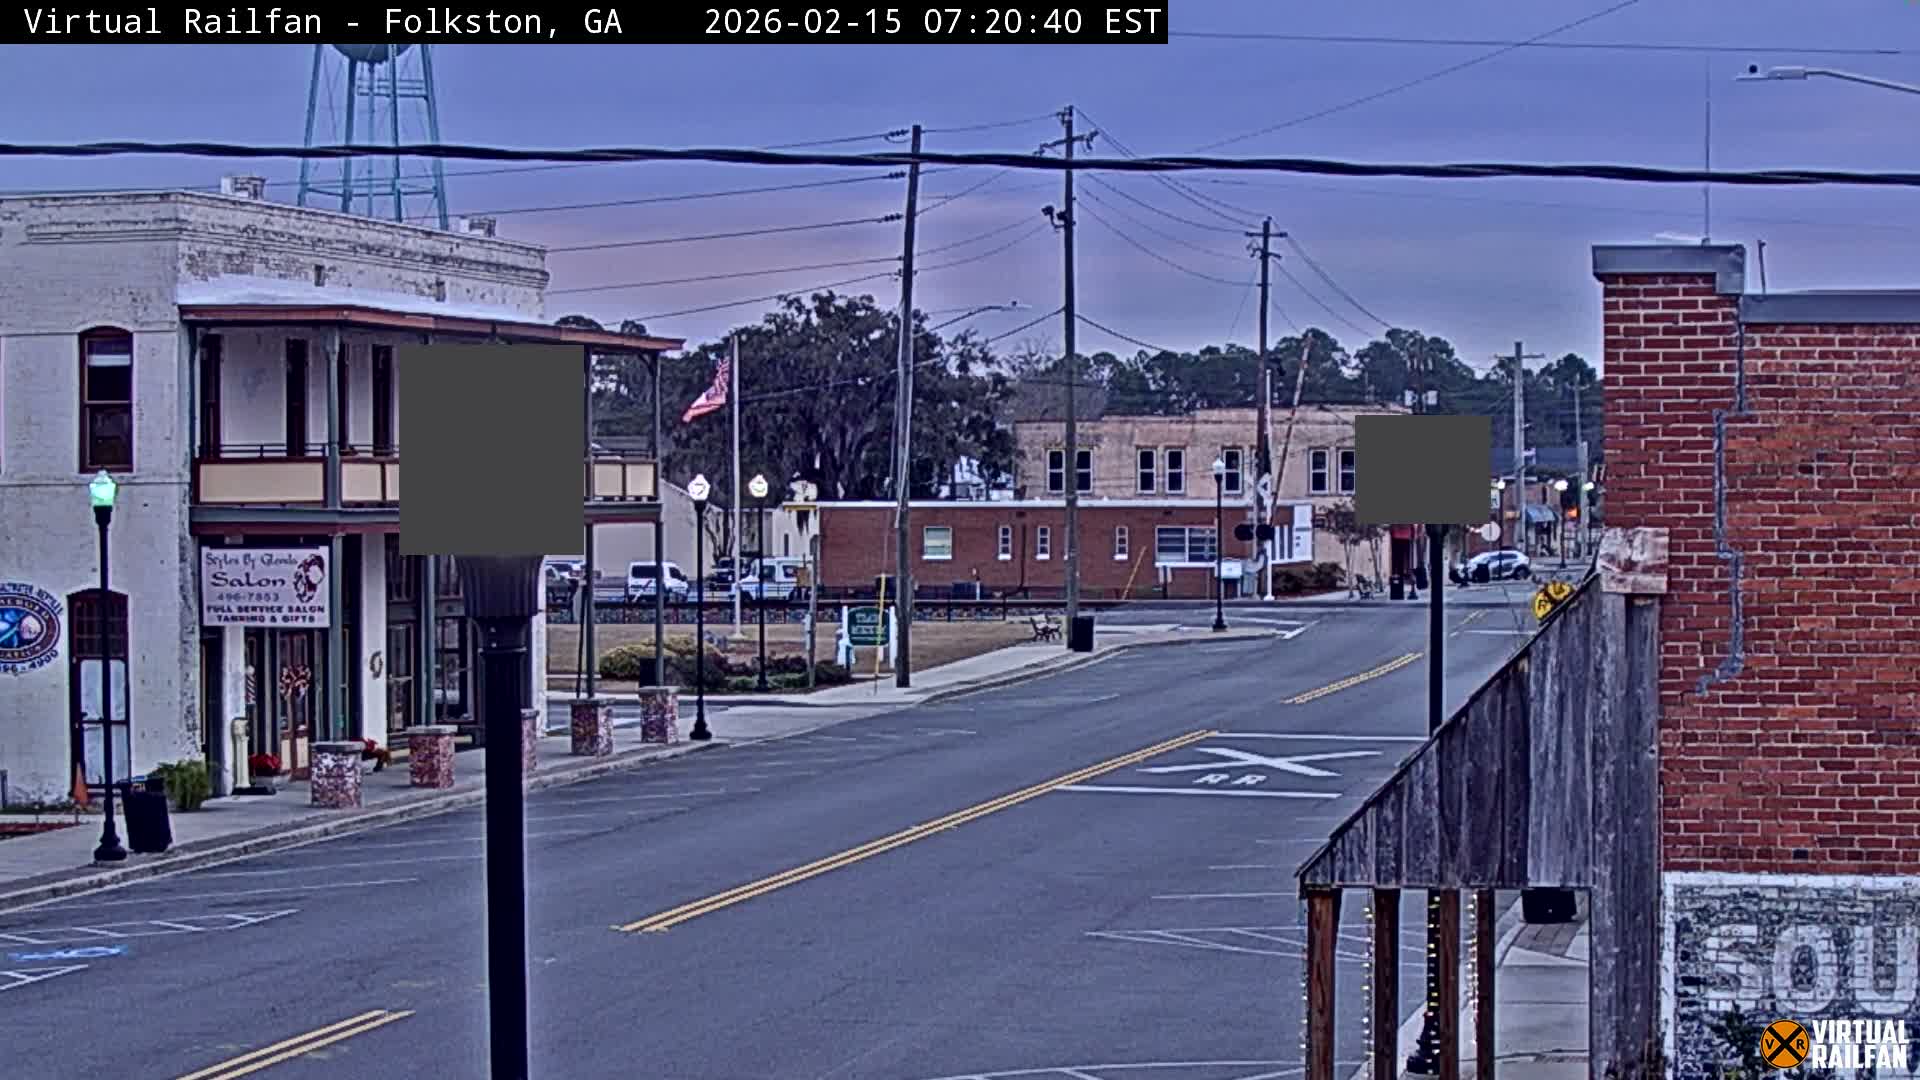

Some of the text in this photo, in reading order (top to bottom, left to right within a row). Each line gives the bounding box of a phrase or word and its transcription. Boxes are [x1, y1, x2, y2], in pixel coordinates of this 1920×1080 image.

[210, 571, 286, 587] Salon
[206, 605, 325, 613] FULL SERVICE SALON
[216, 615, 316, 623] TANNING & GIFTS
